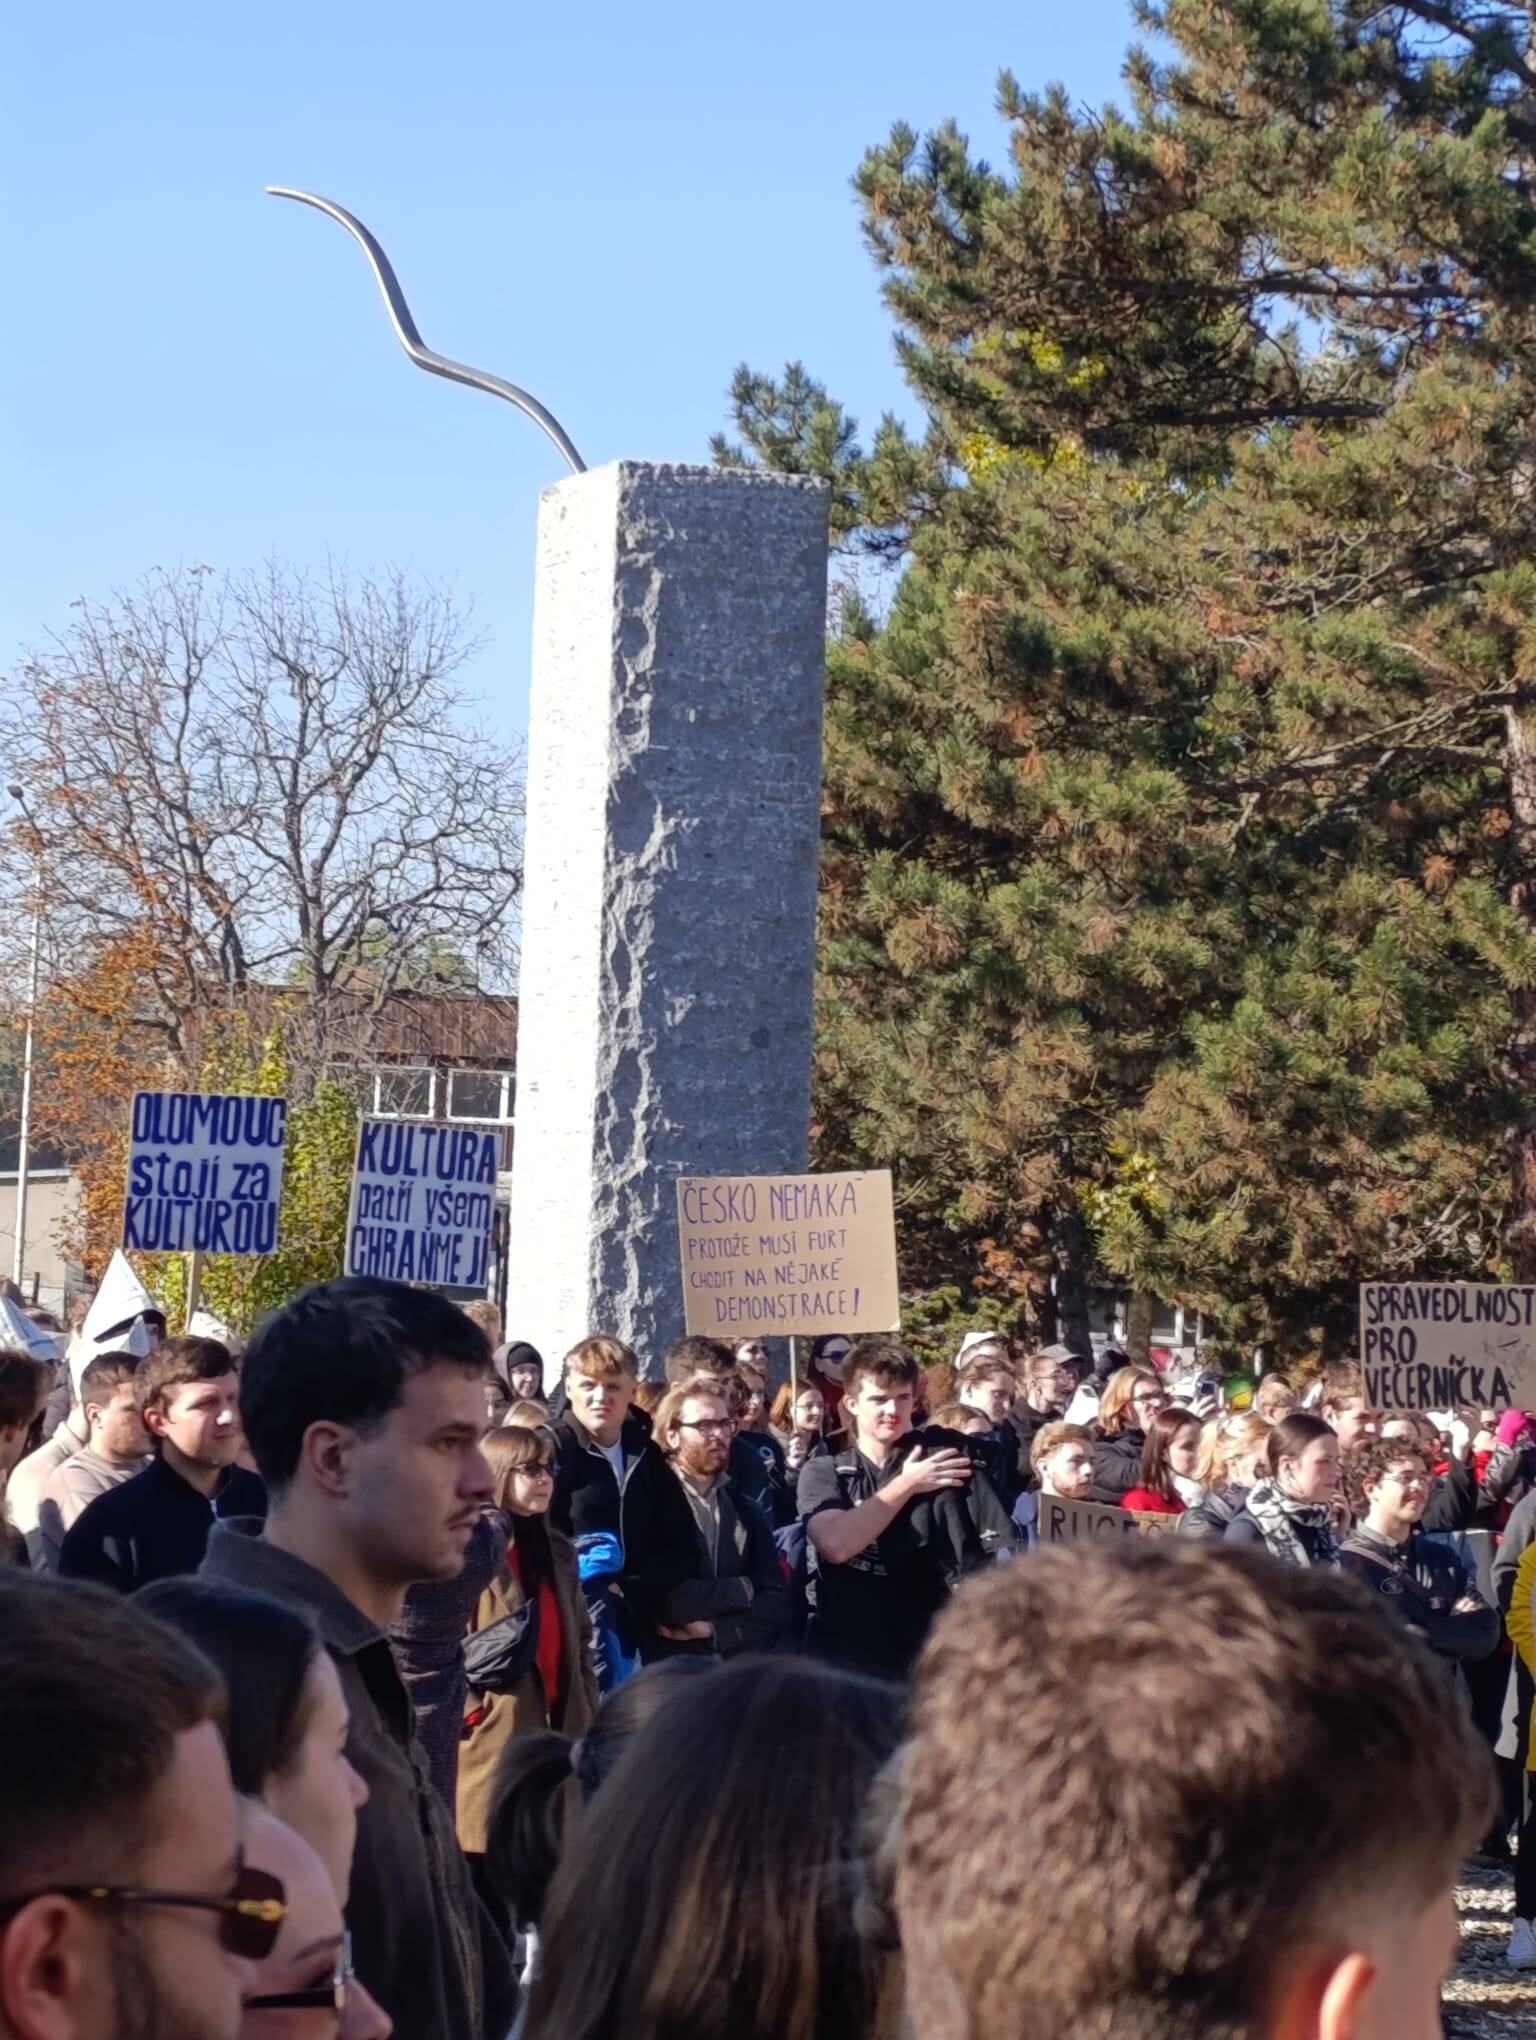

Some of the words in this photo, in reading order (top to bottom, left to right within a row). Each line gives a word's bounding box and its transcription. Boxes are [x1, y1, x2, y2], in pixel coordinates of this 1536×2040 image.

[132, 1092, 287, 1148] OLOMOUC
[131, 1152, 222, 1200] stojí
[231, 1162, 270, 1201] za
[357, 1121, 497, 1185] KULTURA
[123, 1197, 278, 1254] KULTUROU
[357, 1180, 415, 1225] patří
[425, 1183, 492, 1231] všem
[683, 1179, 757, 1225] ČESKO
[769, 1177, 864, 1222] NEMAKÁ
[350, 1224, 464, 1284] CHRAŇME
[688, 1232, 751, 1261] PROTOŽE
[759, 1230, 798, 1257] MUSÍ
[808, 1229, 849, 1251] FURT
[690, 1270, 735, 1289] CHODIT
[744, 1269, 768, 1287] NA
[774, 1258, 844, 1286] NĚJAKÉ
[1365, 1285, 1535, 1326] SPRAVEDLNOST
[1365, 1325, 1418, 1365] PRO
[1364, 1354, 1513, 1410] VEČERNÍČKA
